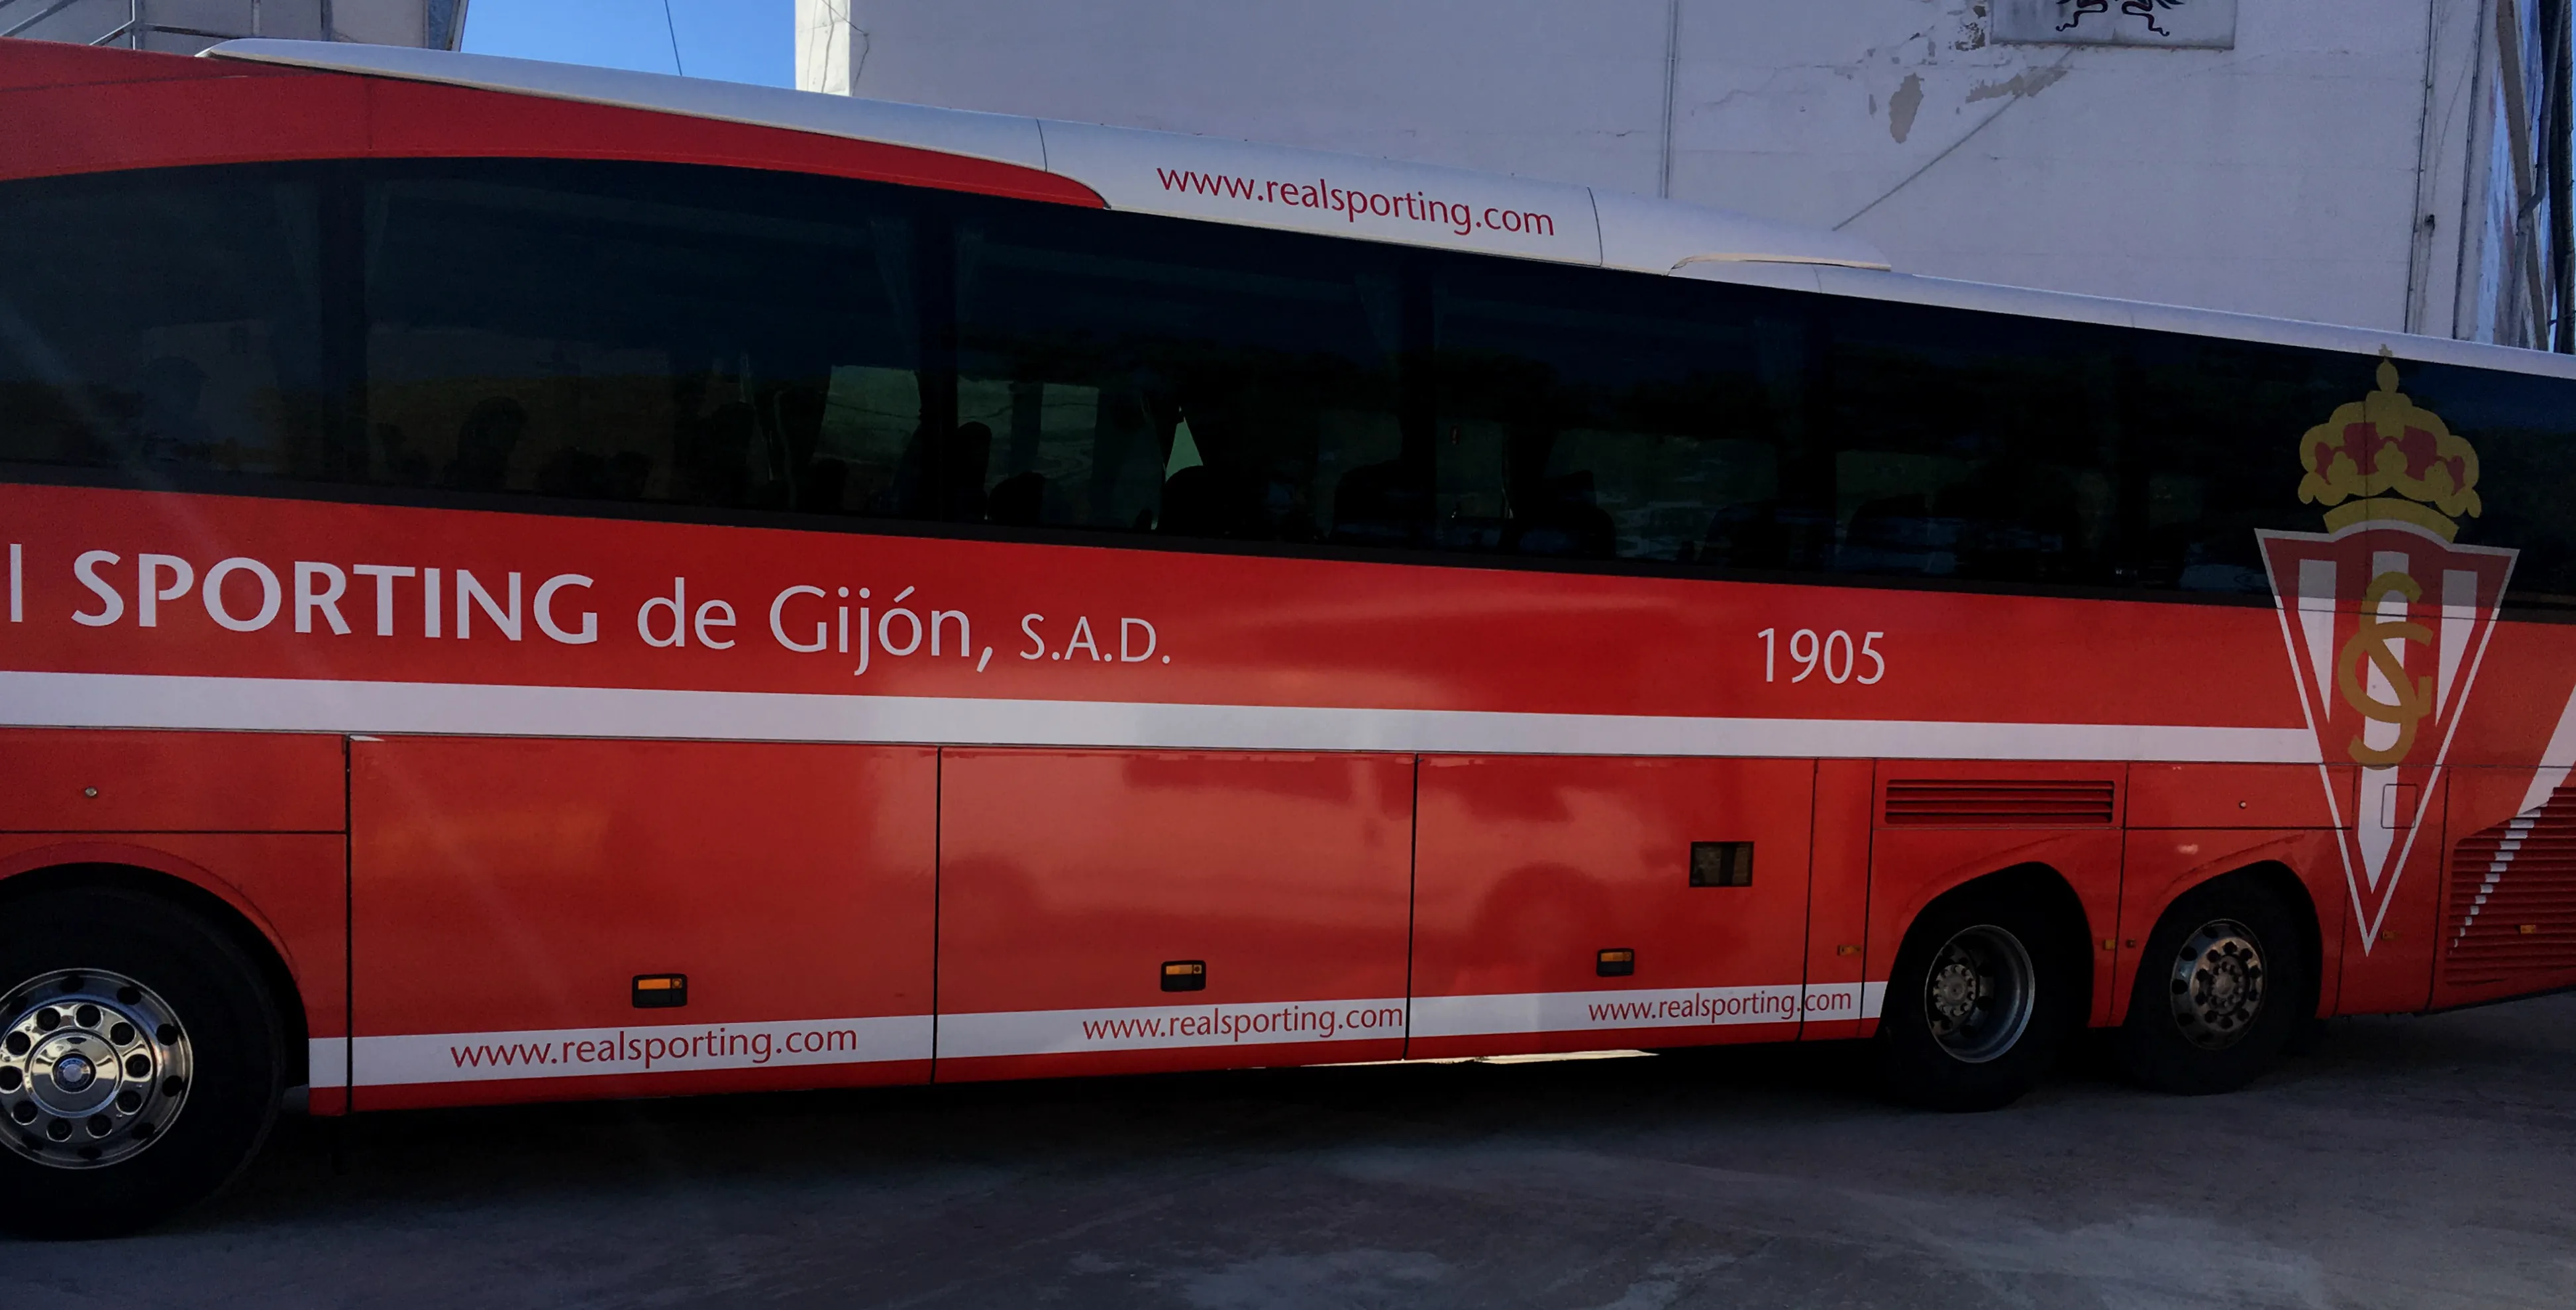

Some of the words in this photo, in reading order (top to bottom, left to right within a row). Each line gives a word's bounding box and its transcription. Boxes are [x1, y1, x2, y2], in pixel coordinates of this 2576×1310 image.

[1157, 167, 1555, 236] www.realsporting.com
[70, 549, 599, 645] SPORTING
[636, 576, 737, 650] de
[769, 584, 994, 676] Gijón,
[1019, 613, 1171, 664] S.A.D.
[1757, 627, 1886, 685] 1905
[1082, 1005, 1403, 1042] www.realsporting.com
[1588, 990, 1852, 1024] www.realsporting.com
[450, 1028, 857, 1069] www.realsporting.com
